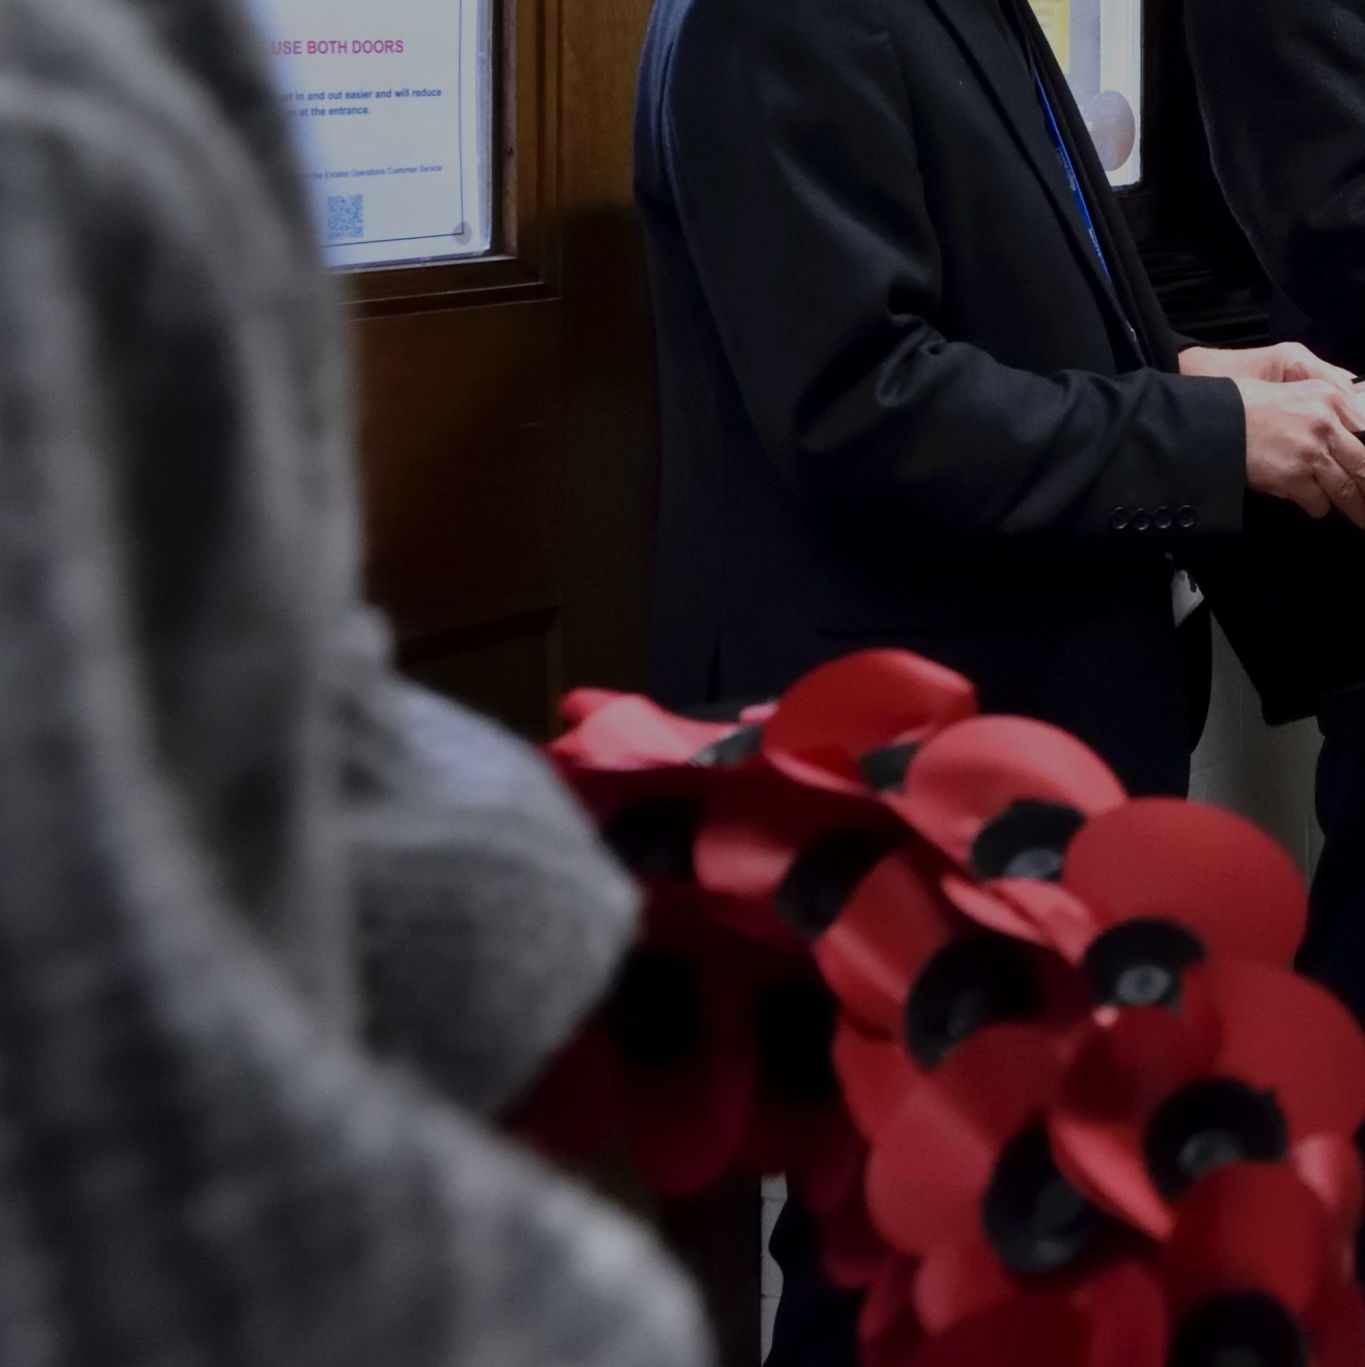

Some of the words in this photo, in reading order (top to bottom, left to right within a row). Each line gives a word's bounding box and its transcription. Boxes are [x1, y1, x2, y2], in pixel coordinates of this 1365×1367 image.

[271, 41, 302, 55] USE
[307, 41, 347, 54] BOTH
[352, 40, 404, 53] DOORS
[307, 90, 325, 101] and
[328, 89, 342, 100] out
[345, 89, 372, 100] easier
[375, 89, 392, 98] and
[394, 88, 410, 97] will
[412, 88, 442, 98] reduce
[311, 107, 326, 116] the
